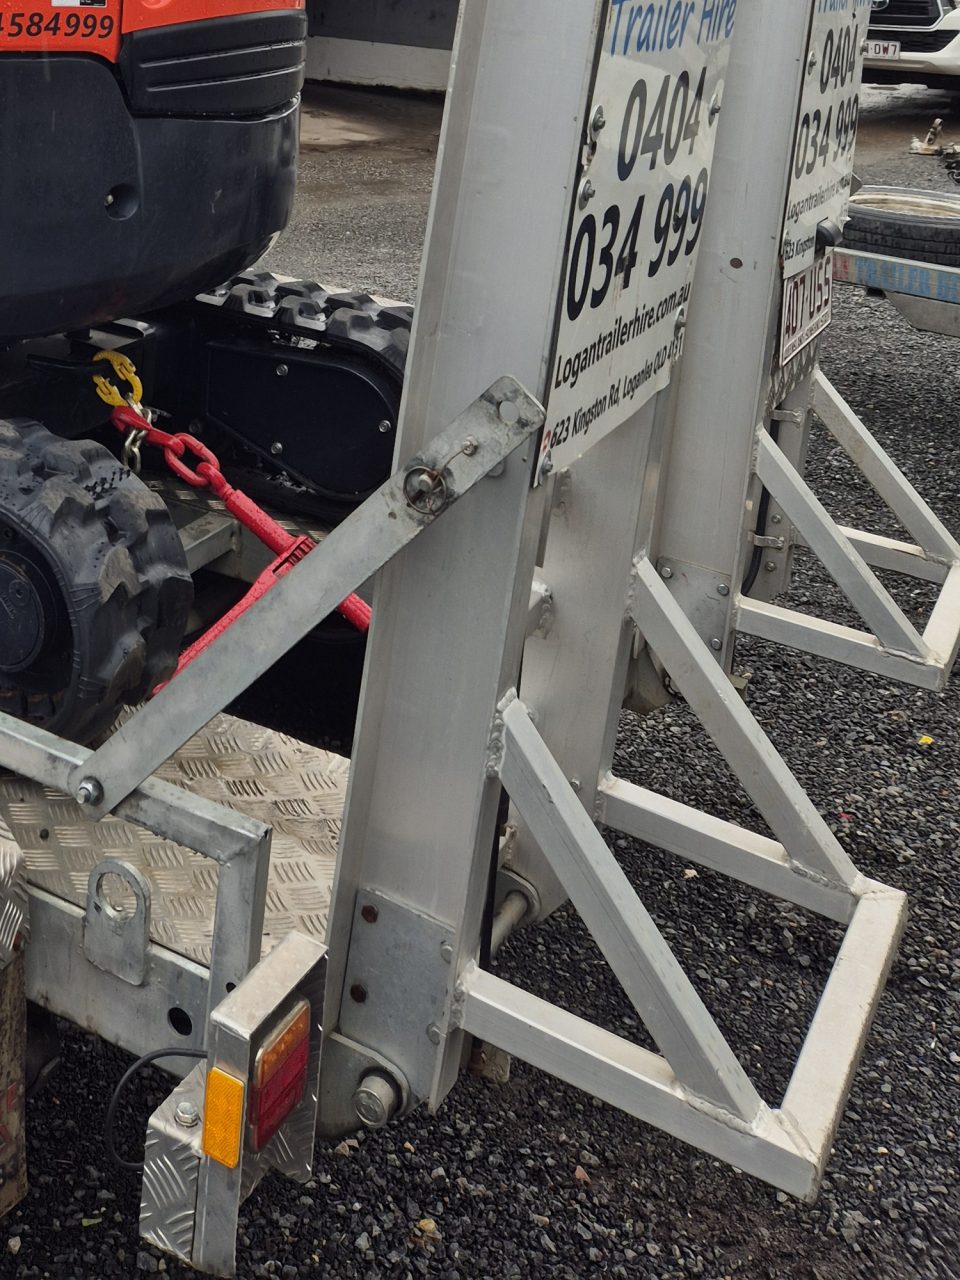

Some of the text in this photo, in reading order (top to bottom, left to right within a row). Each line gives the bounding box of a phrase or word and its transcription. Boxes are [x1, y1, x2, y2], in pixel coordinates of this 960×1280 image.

[820, 24, 858, 94] 0404
[617, 65, 707, 181] 0404
[795, 93, 859, 180] 034 999
[567, 167, 708, 321] 034 999
[554, 282, 691, 390] Logantrailerhire.com.au
[550, 416, 571, 450] 623
[571, 395, 607, 437] Kingston
[608, 378, 621, 407] Rd,
[622, 359, 654, 401] Loganlea
[653, 344, 667, 375] QLD
